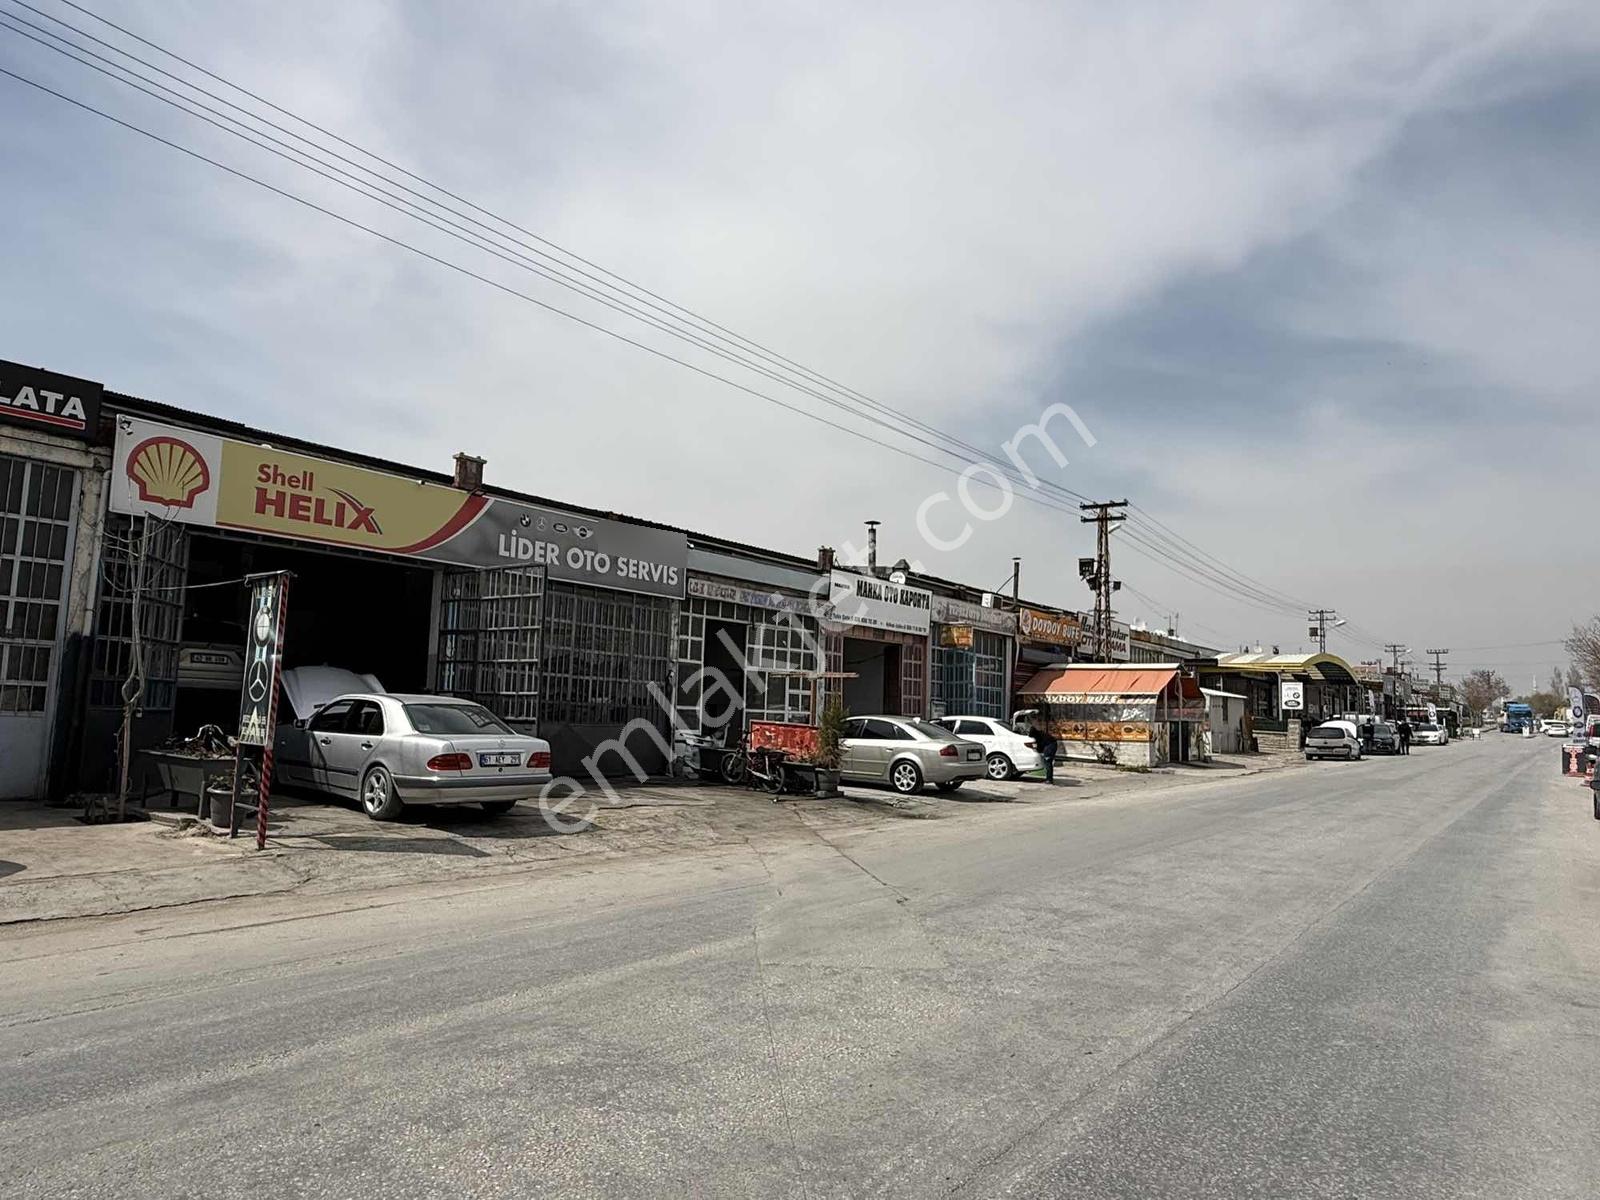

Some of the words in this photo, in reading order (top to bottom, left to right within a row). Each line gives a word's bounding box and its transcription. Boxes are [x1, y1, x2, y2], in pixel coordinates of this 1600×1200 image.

[257, 463, 314, 491] Shell
[255, 486, 382, 535] HELIX
[498, 529, 560, 566] LİDER
[566, 547, 611, 573] OTO
[856, 579, 882, 601] MARKA
[884, 585, 899, 604] OTO
[900, 589, 930, 610] KAPORTA
